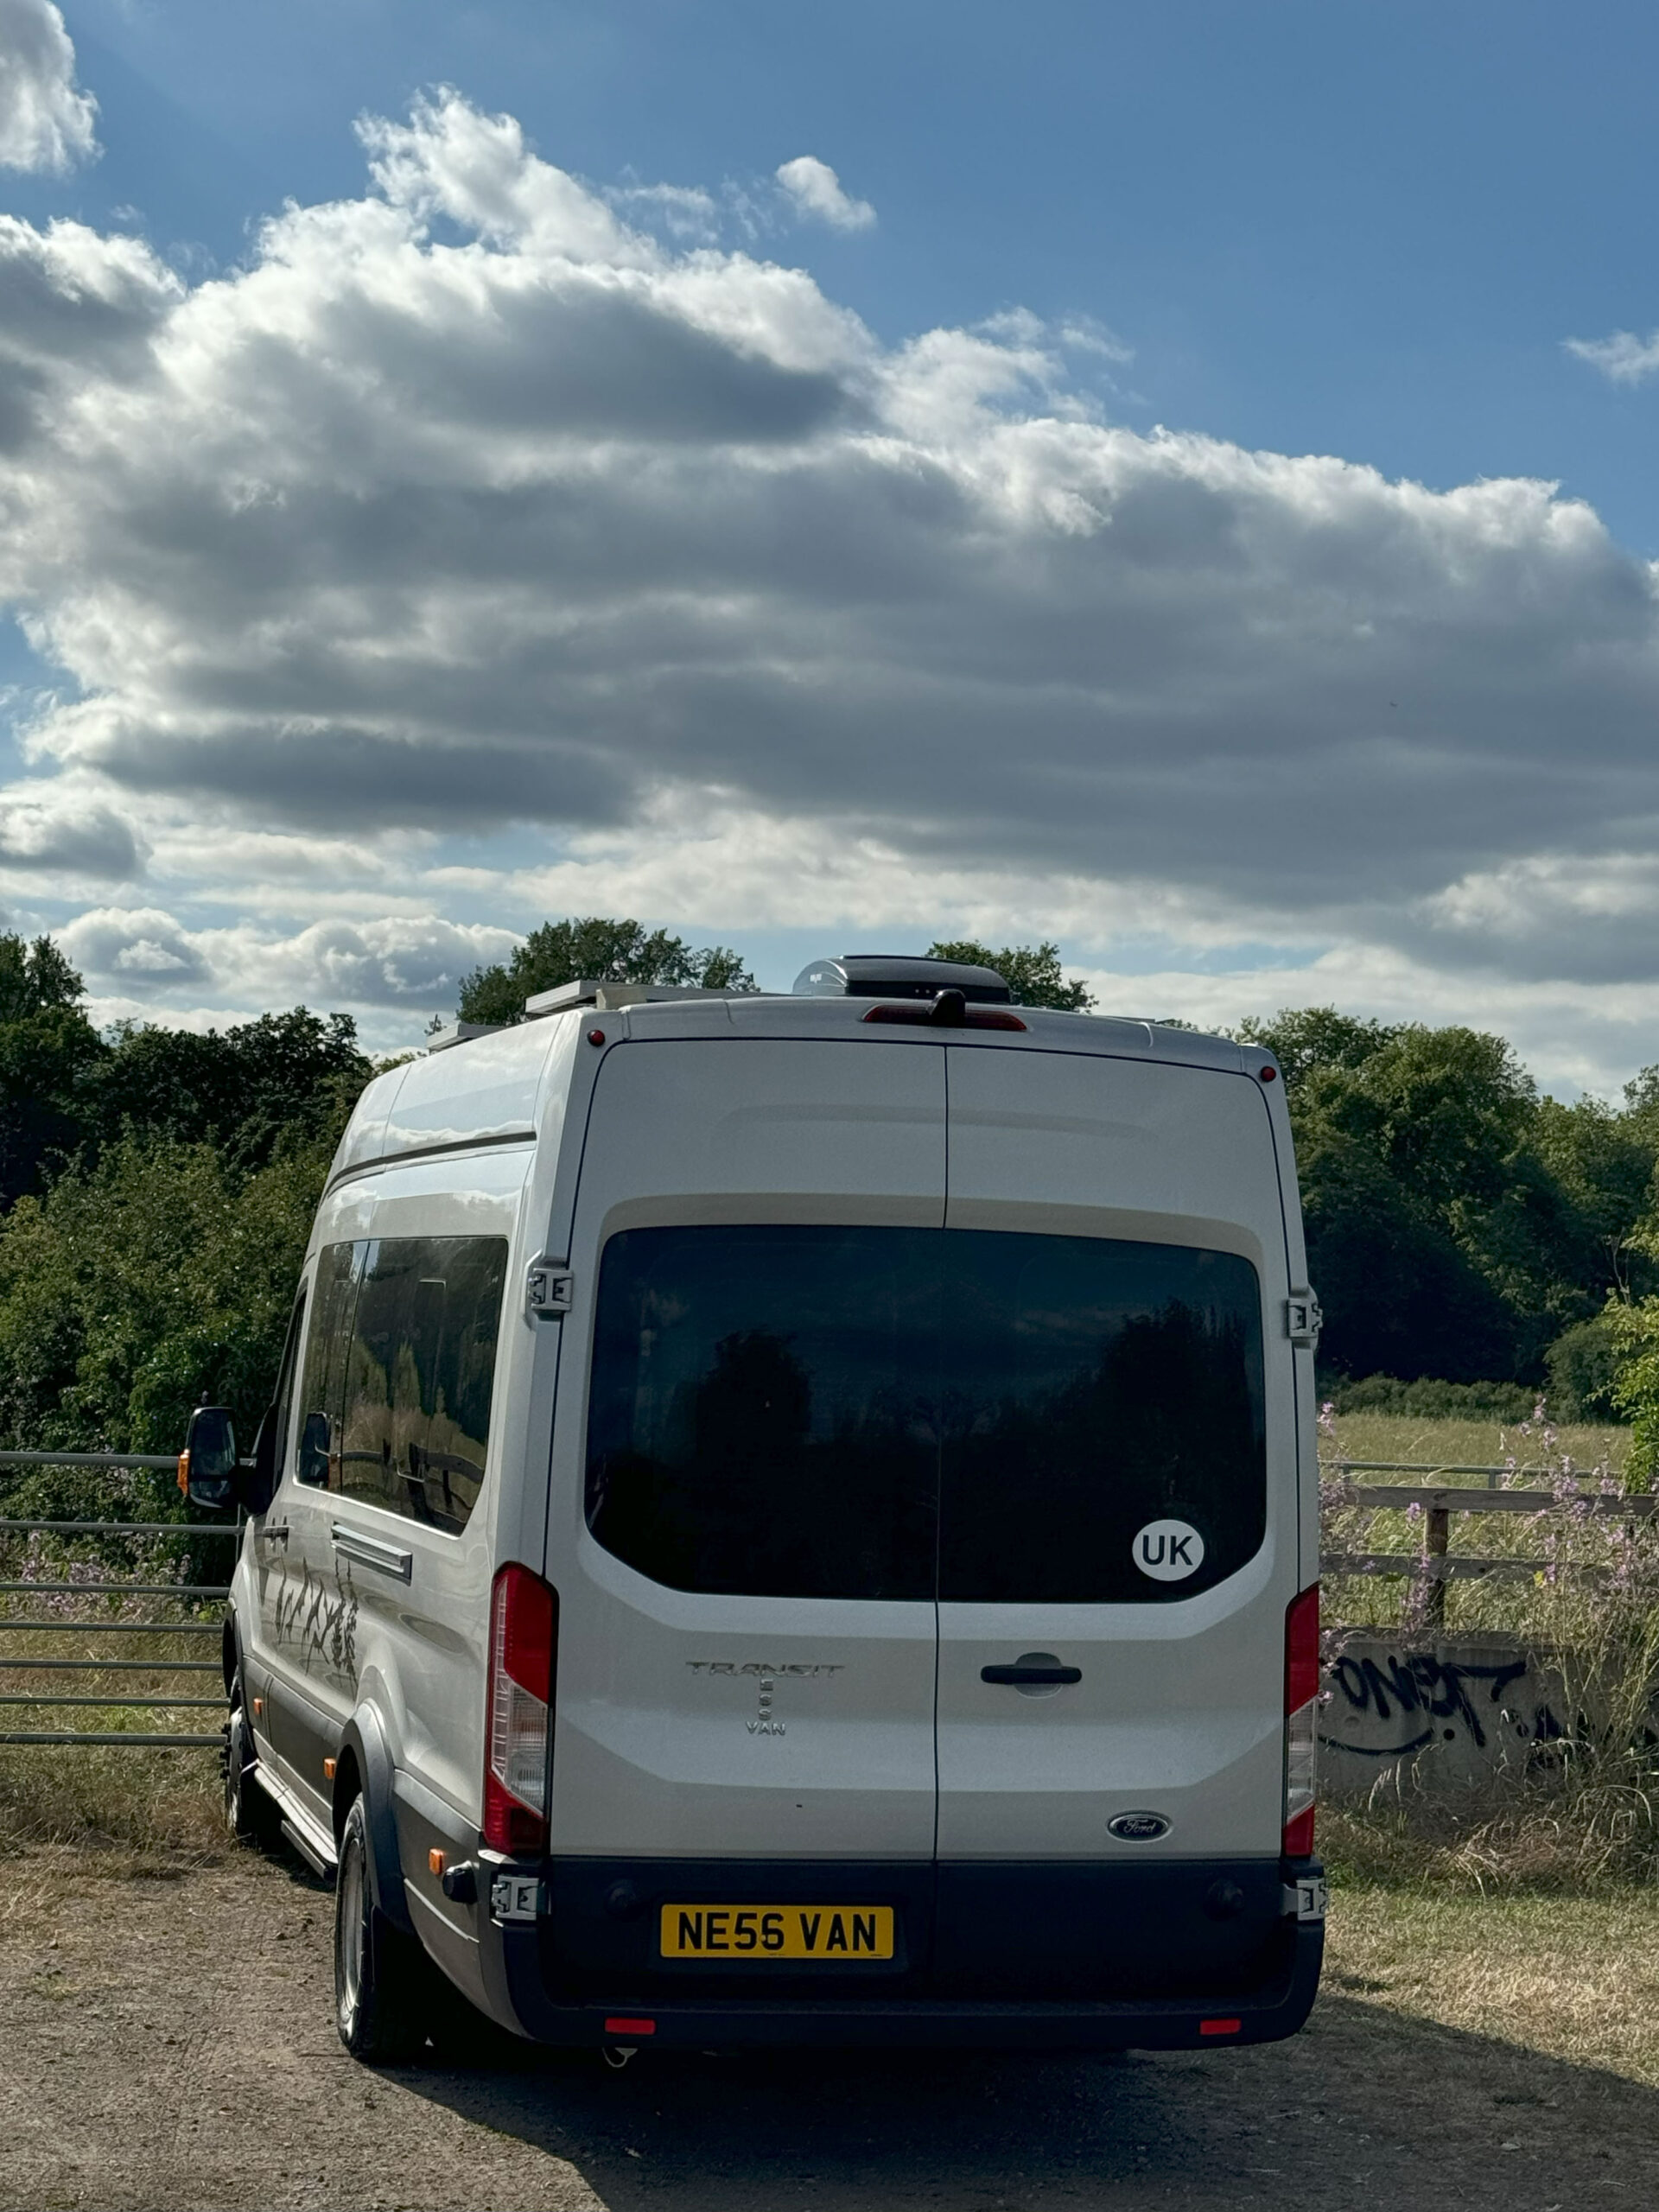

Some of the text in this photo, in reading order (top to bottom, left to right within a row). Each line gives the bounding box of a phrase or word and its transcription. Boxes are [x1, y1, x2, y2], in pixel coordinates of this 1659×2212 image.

[1142, 1535, 1193, 1566] UK
[685, 1662, 846, 1678] TRANSIT
[746, 1721, 786, 1736] VAN
[1123, 1819, 1157, 1834] Ford
[678, 1912, 876, 1951] NE56 VAN
